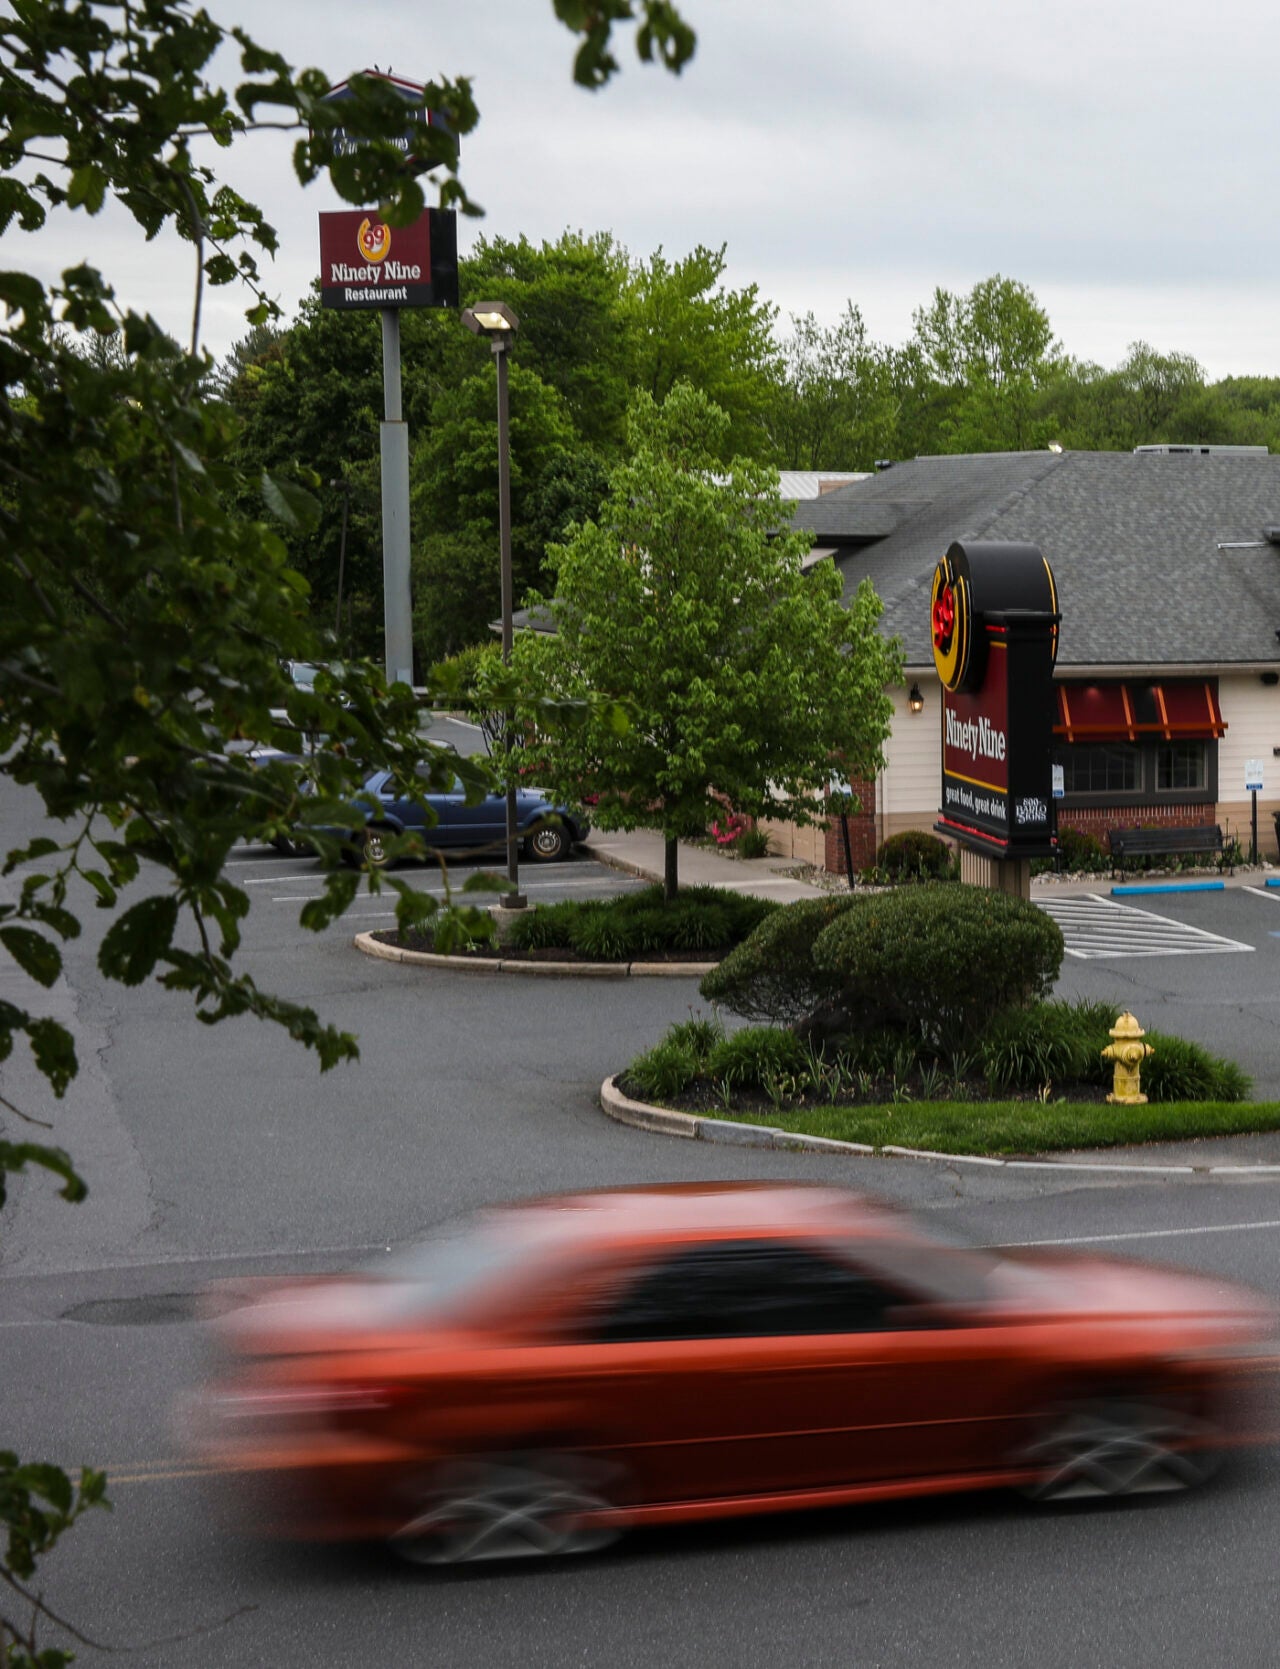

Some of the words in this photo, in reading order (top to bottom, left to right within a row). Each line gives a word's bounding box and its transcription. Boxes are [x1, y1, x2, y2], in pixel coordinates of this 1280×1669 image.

[363, 225, 385, 250] 99
[331, 263, 381, 284] Ninety
[384, 261, 421, 280] Nine
[344, 286, 407, 301] Restaurant
[945, 707, 979, 761] Ninety
[978, 715, 1006, 762] Nine
[945, 787, 960, 804] great
[960, 787, 975, 810] food,
[975, 797, 990, 815] great
[990, 798, 1007, 820] drink
